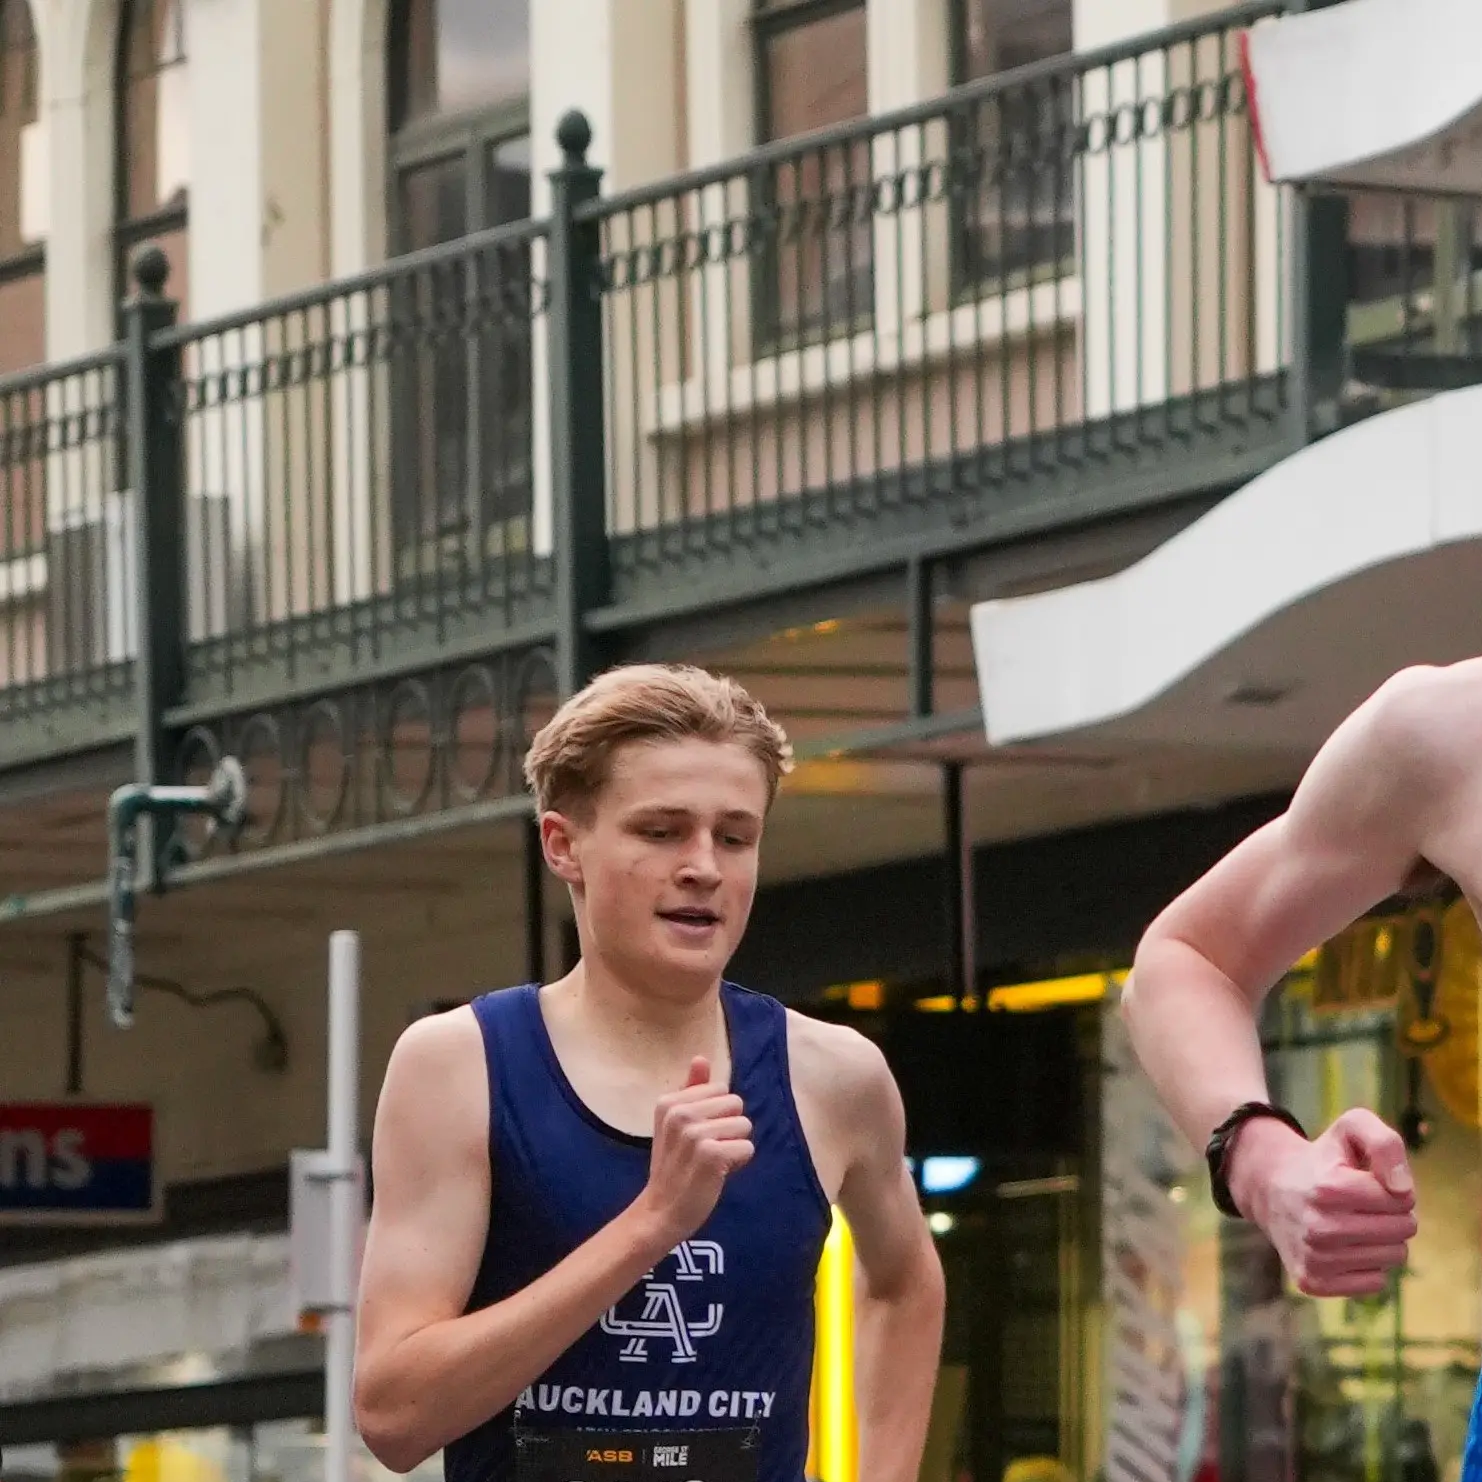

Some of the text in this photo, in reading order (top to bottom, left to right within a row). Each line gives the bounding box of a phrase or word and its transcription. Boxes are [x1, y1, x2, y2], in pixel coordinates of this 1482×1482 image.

[515, 1384, 775, 1418] AUCKLAND CITY
[586, 1450, 633, 1463] ASB
[653, 1453, 687, 1467] MILE
